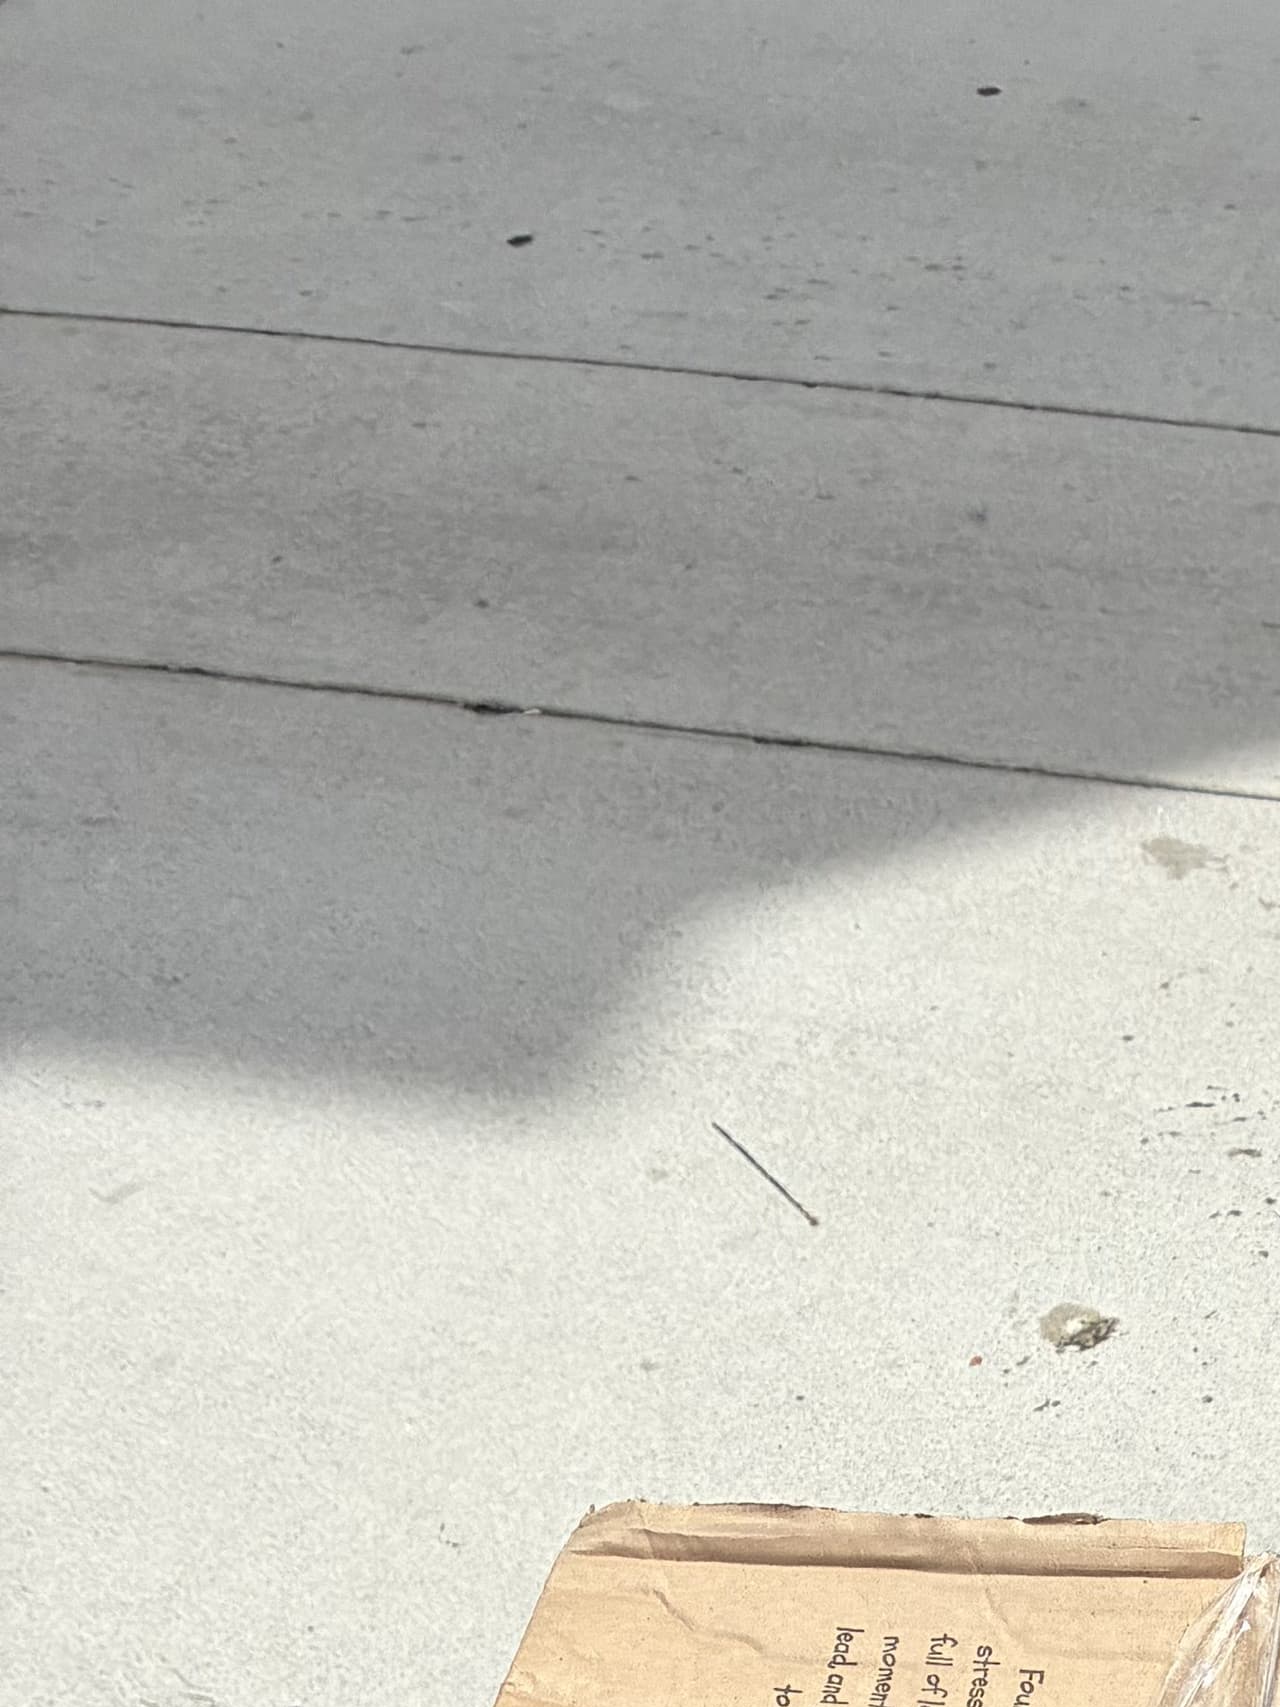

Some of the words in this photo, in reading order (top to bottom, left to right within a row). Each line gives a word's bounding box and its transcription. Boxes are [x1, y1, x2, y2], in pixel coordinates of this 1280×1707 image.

[923, 1631, 959, 1667] full
[771, 1682, 804, 1707] to
[818, 1672, 850, 1705] and
[919, 1672, 949, 1699] of
